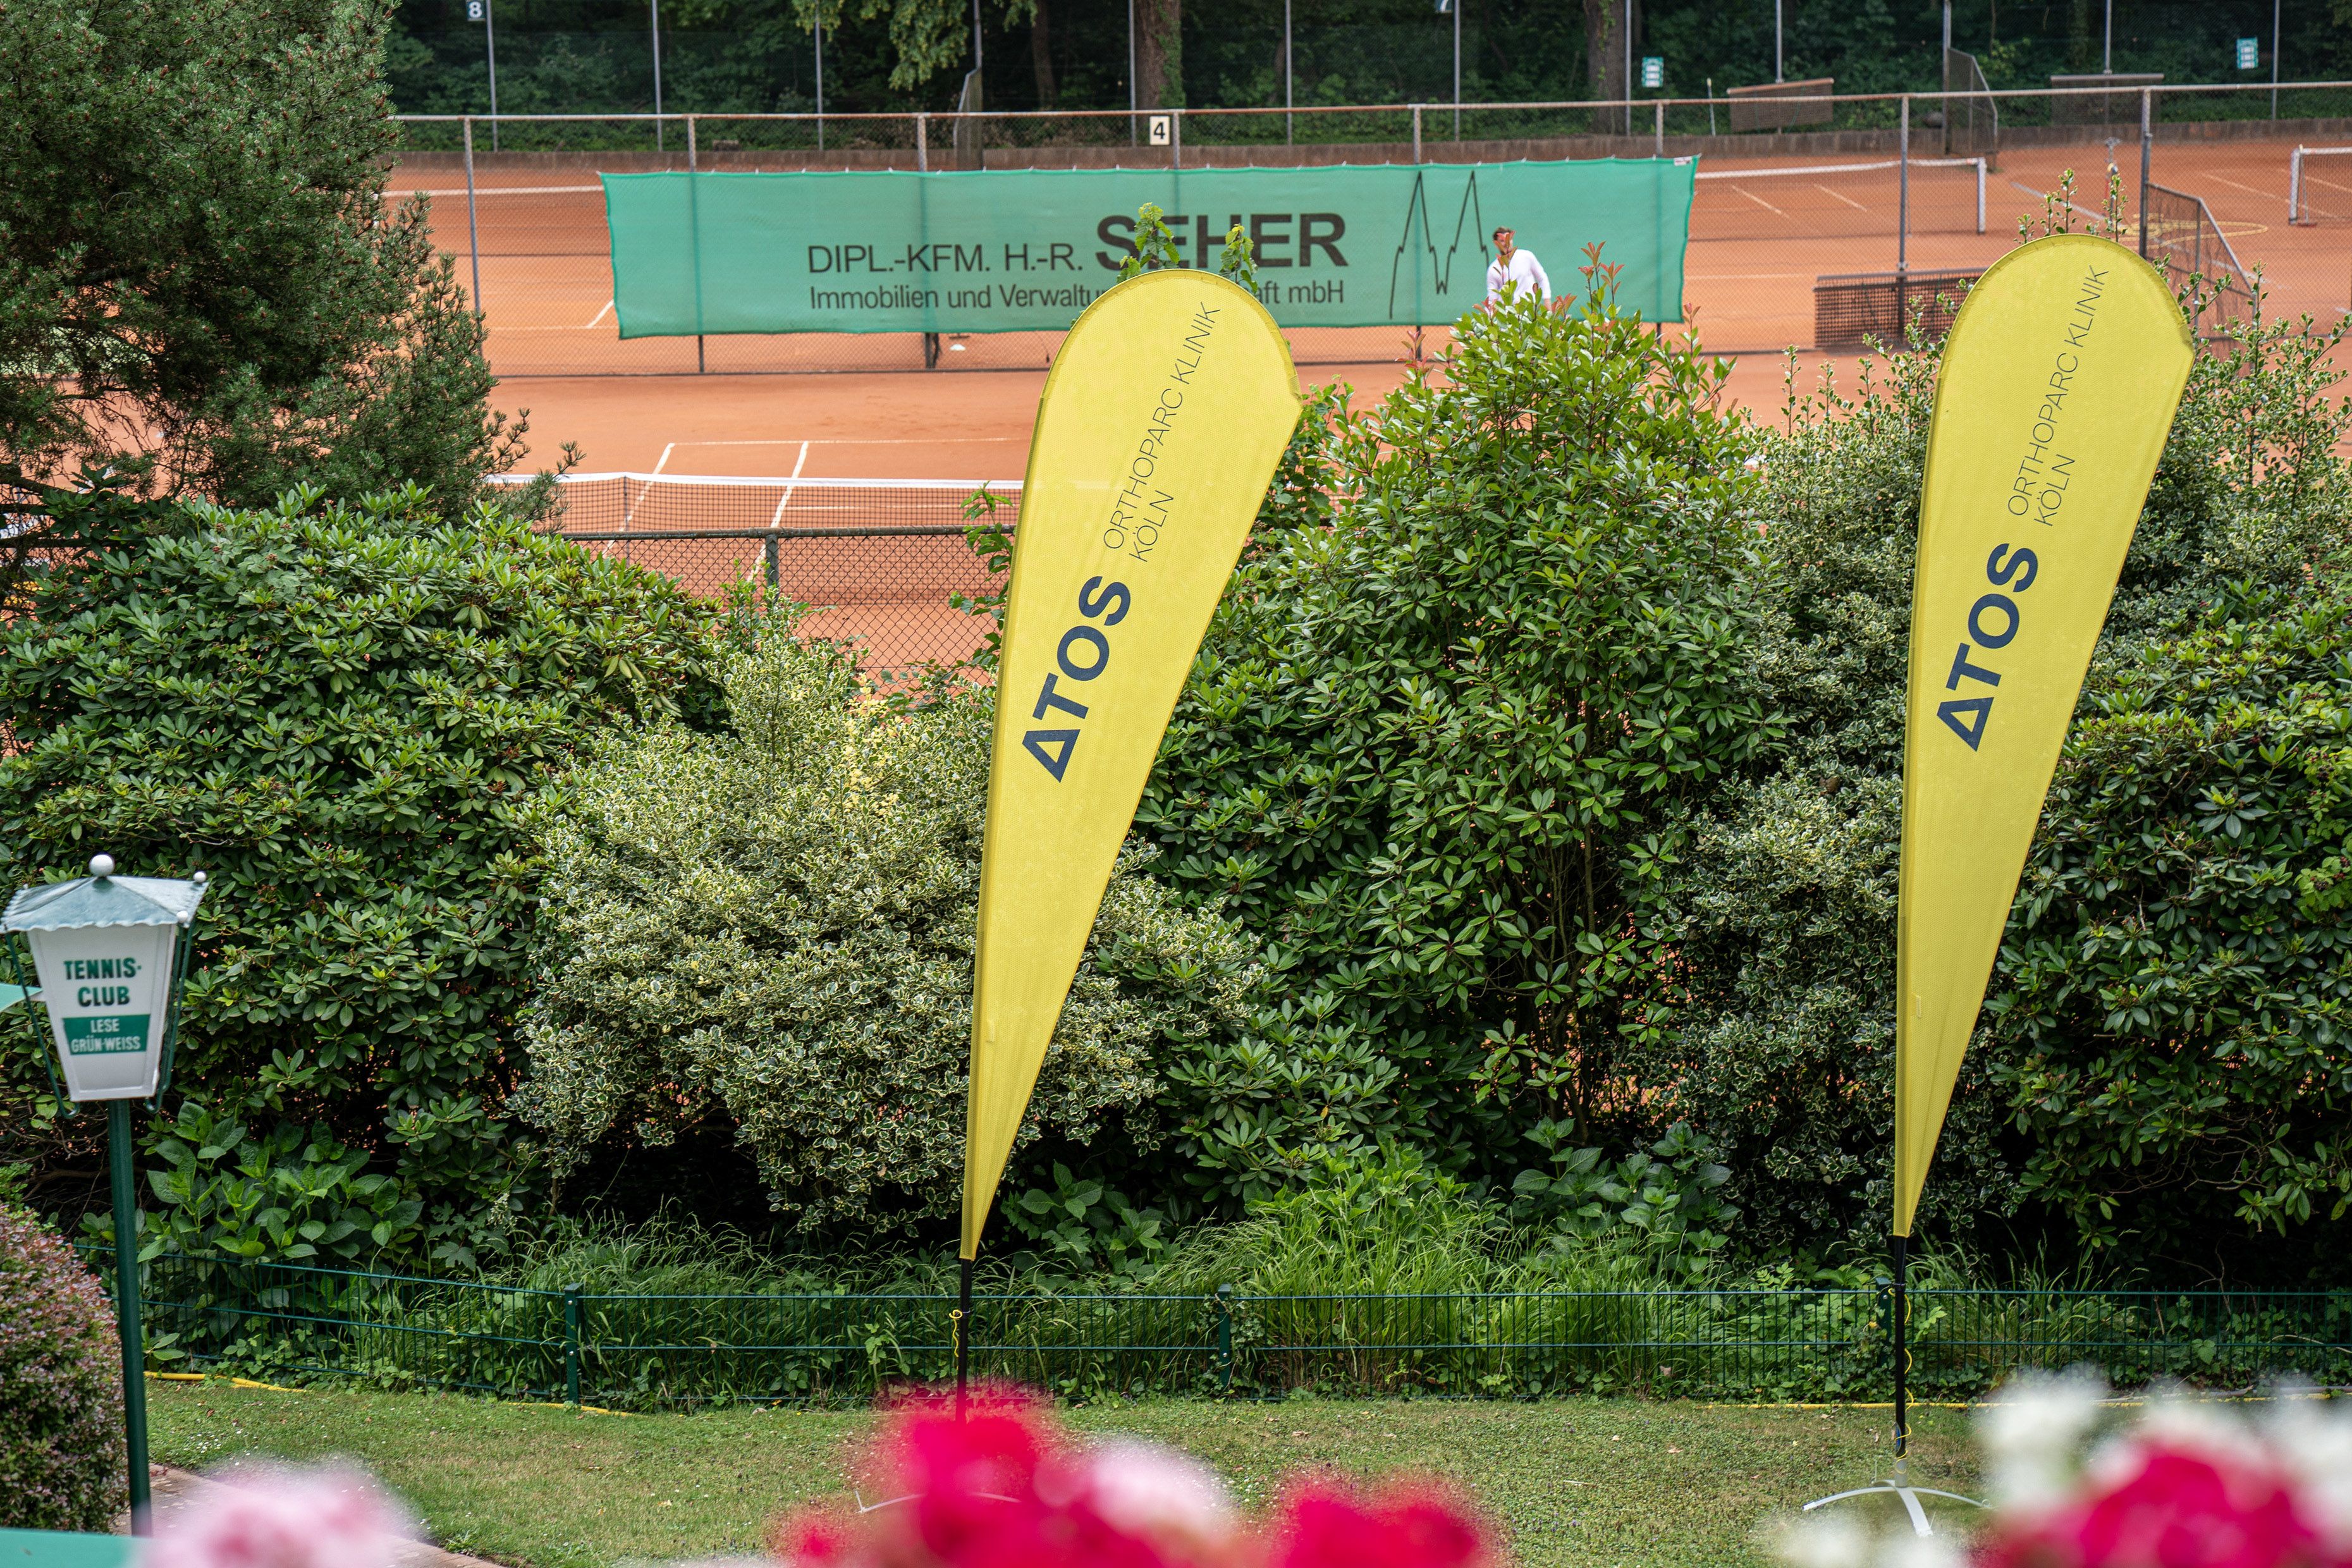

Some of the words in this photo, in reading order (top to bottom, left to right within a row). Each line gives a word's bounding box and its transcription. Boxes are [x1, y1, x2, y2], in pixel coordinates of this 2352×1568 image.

[469, 1, 482, 18] 8
[1154, 122, 1166, 139] 4
[807, 243, 991, 273] DIPL.-KFM.
[1004, 243, 1083, 271] H.-R.
[1095, 212, 1349, 271] SEHER
[810, 285, 939, 309] Immobilien
[948, 285, 991, 308] und
[999, 284, 1106, 307] Verwaltu
[1288, 279, 1344, 303] mbH
[2007, 352, 2078, 516] ORTHOPARC
[2064, 265, 2109, 347] KLINIK
[1103, 388, 1183, 549] ORTHOPARC
[1170, 301, 1221, 385] KLINIK
[2034, 453, 2075, 526] KÖLN
[1129, 489, 1174, 562] KÖLN
[78, 986, 130, 1007] CLUB
[90, 1018, 120, 1033] LESE
